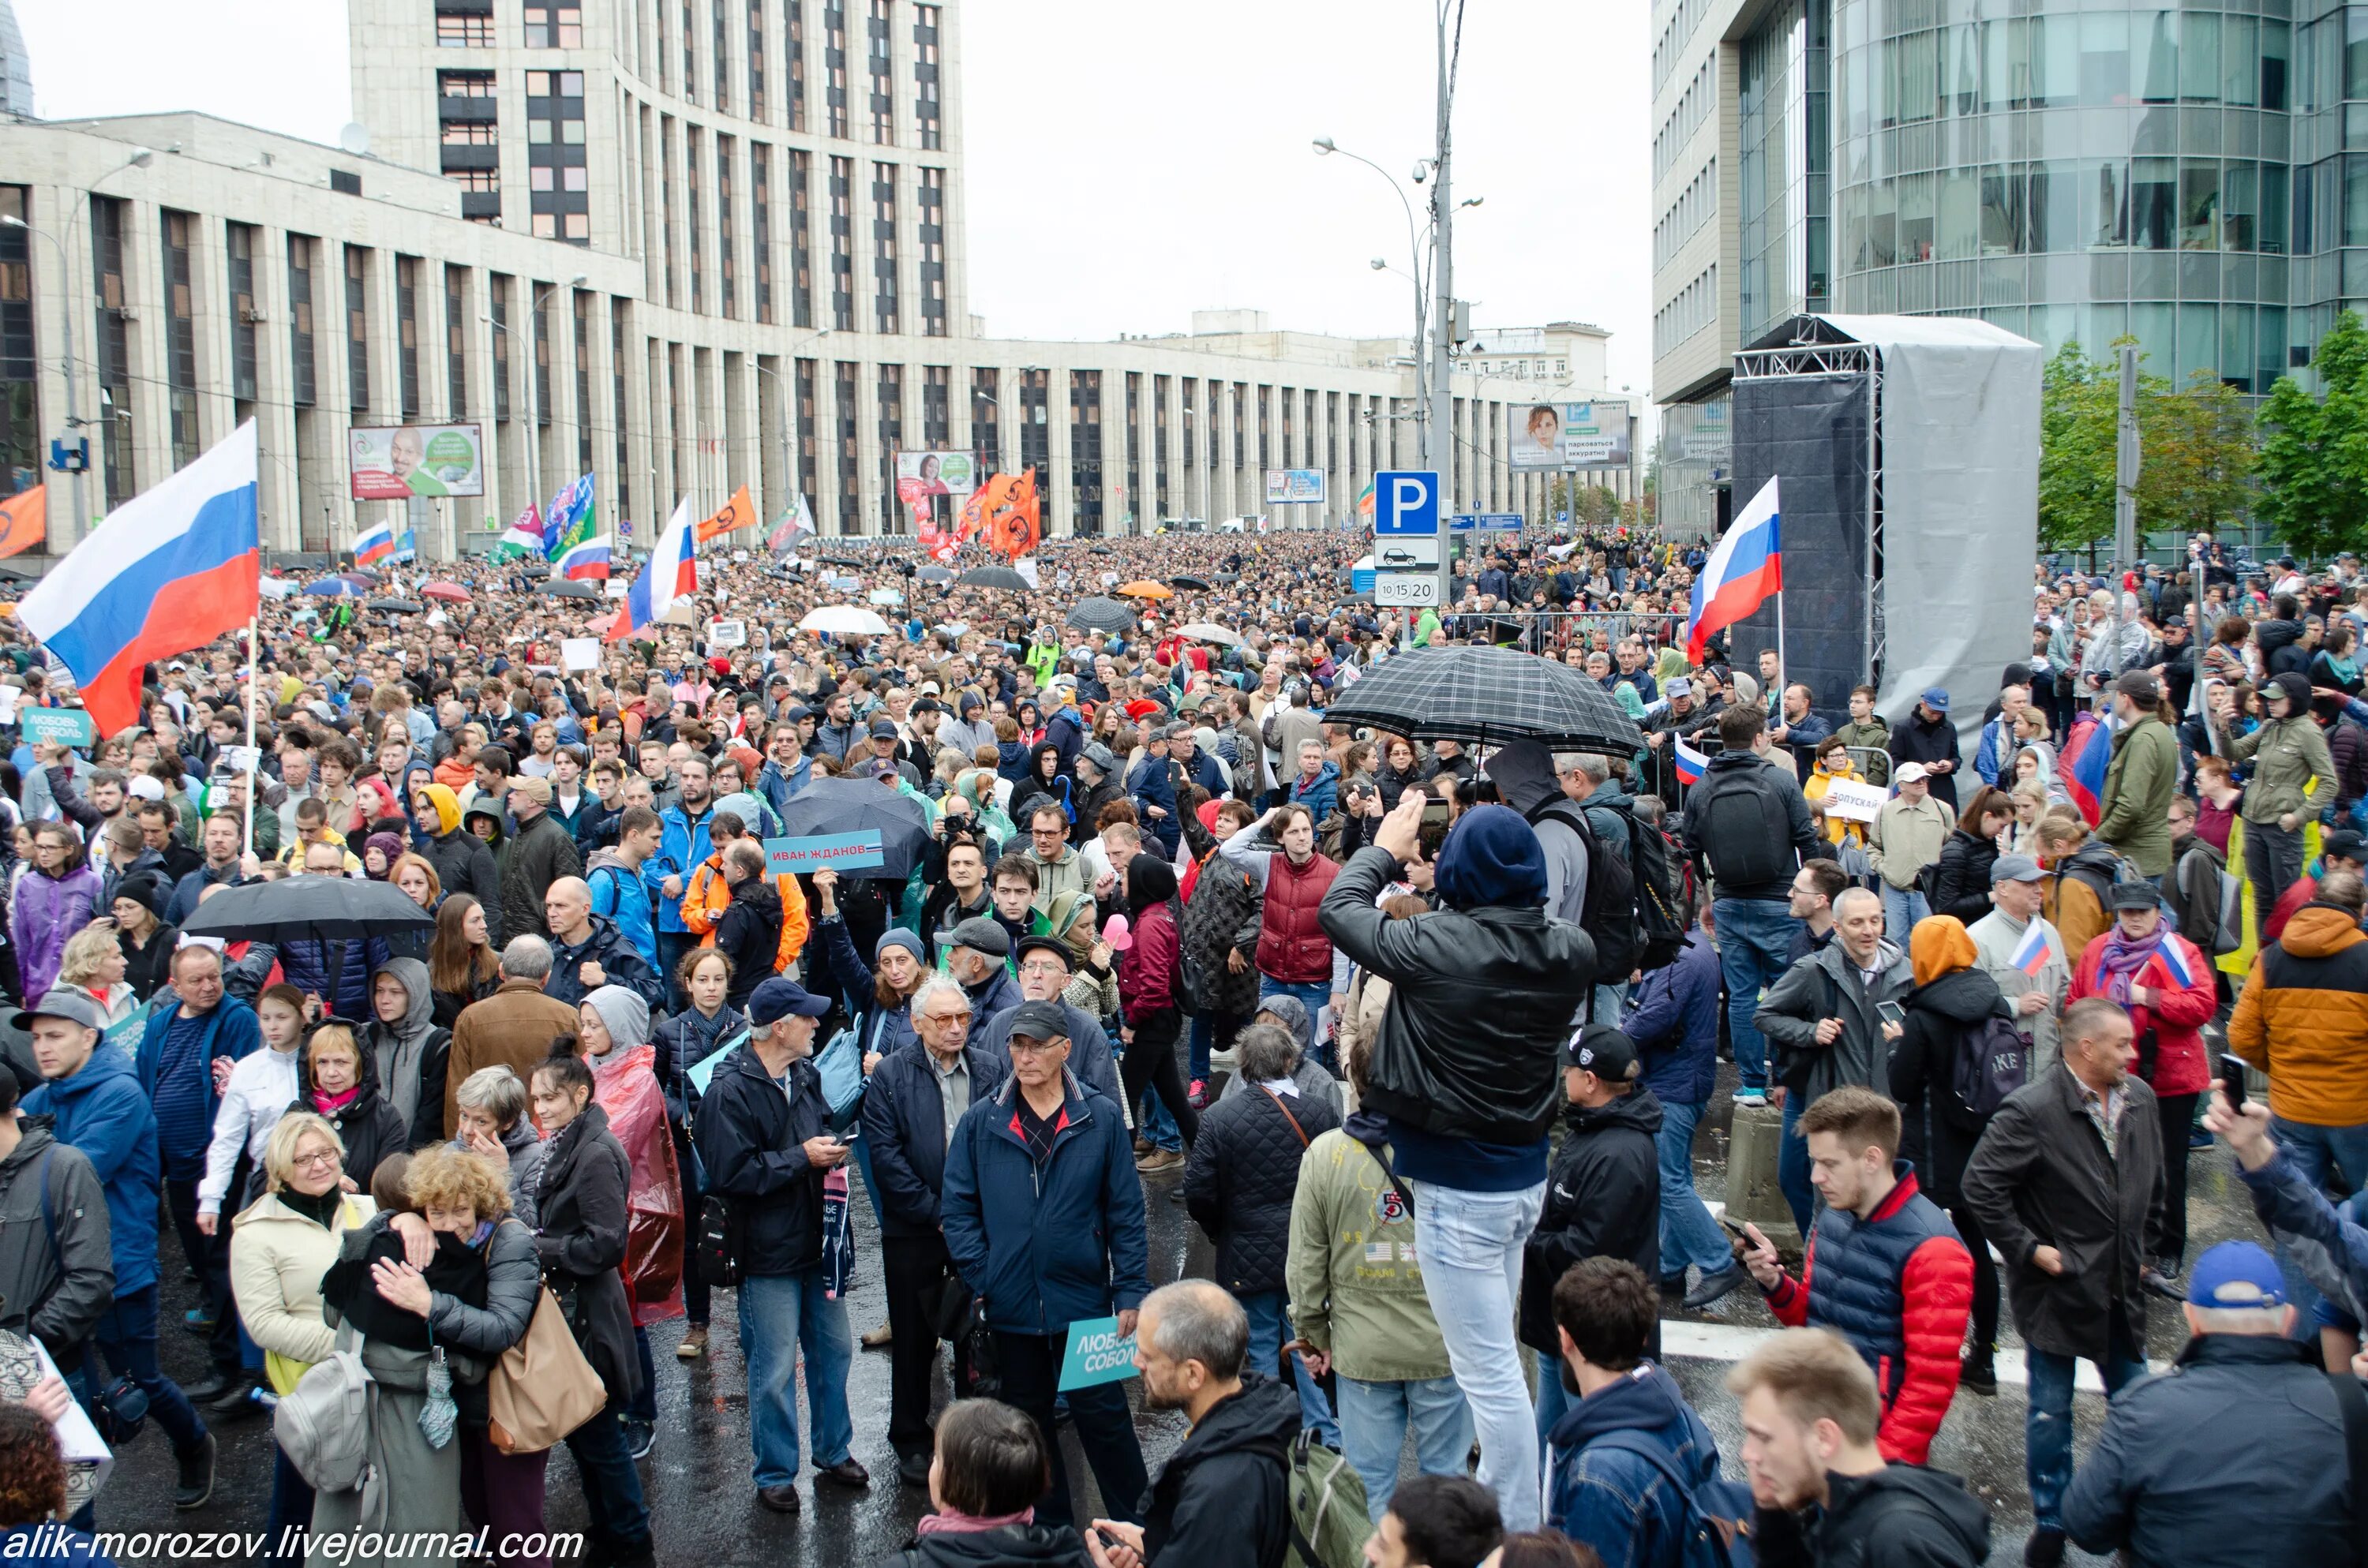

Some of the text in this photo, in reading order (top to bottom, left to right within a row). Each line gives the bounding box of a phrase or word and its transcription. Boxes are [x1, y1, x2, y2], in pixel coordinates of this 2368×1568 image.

[1393, 478, 1427, 529] P
[1560, 512, 1567, 521] P
[1383, 584, 1430, 597] 10 15 20
[30, 714, 80, 727] ЛЮБОВЬ
[36, 726, 83, 739] СОБОЛЬ
[773, 845, 865, 861] ИВАН ЖДАНОВ
[1085, 1346, 1137, 1372] СОБОЛ
